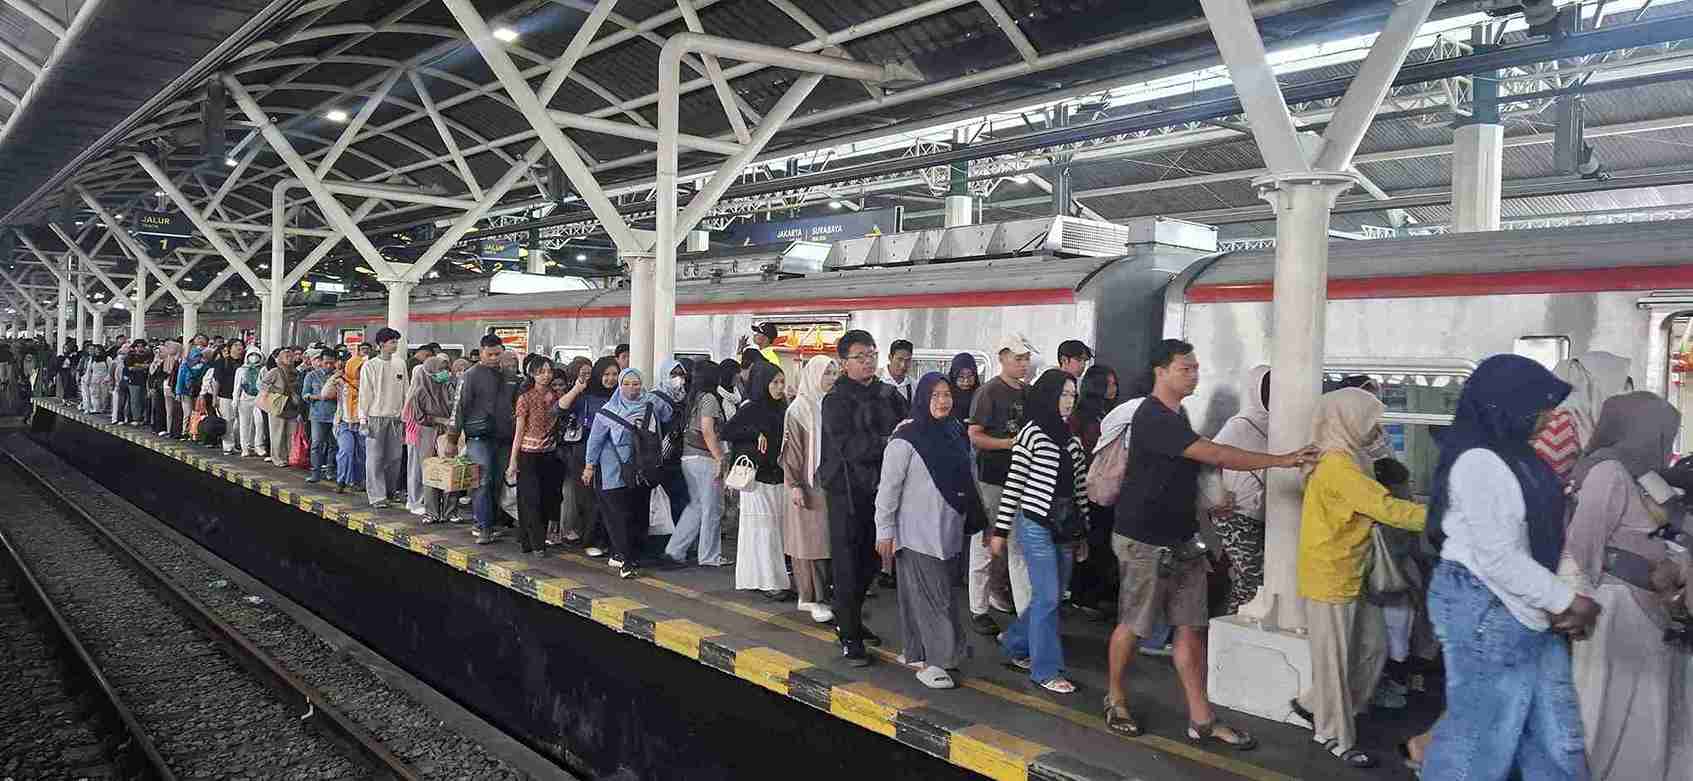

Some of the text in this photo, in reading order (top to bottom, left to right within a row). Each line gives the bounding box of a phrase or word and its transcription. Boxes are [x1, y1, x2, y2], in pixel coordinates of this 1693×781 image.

[143, 216, 170, 224] JALUR
[776, 228, 802, 238] JAKARTA
[812, 224, 842, 234] SURABAYA
[160, 238, 168, 249] 1
